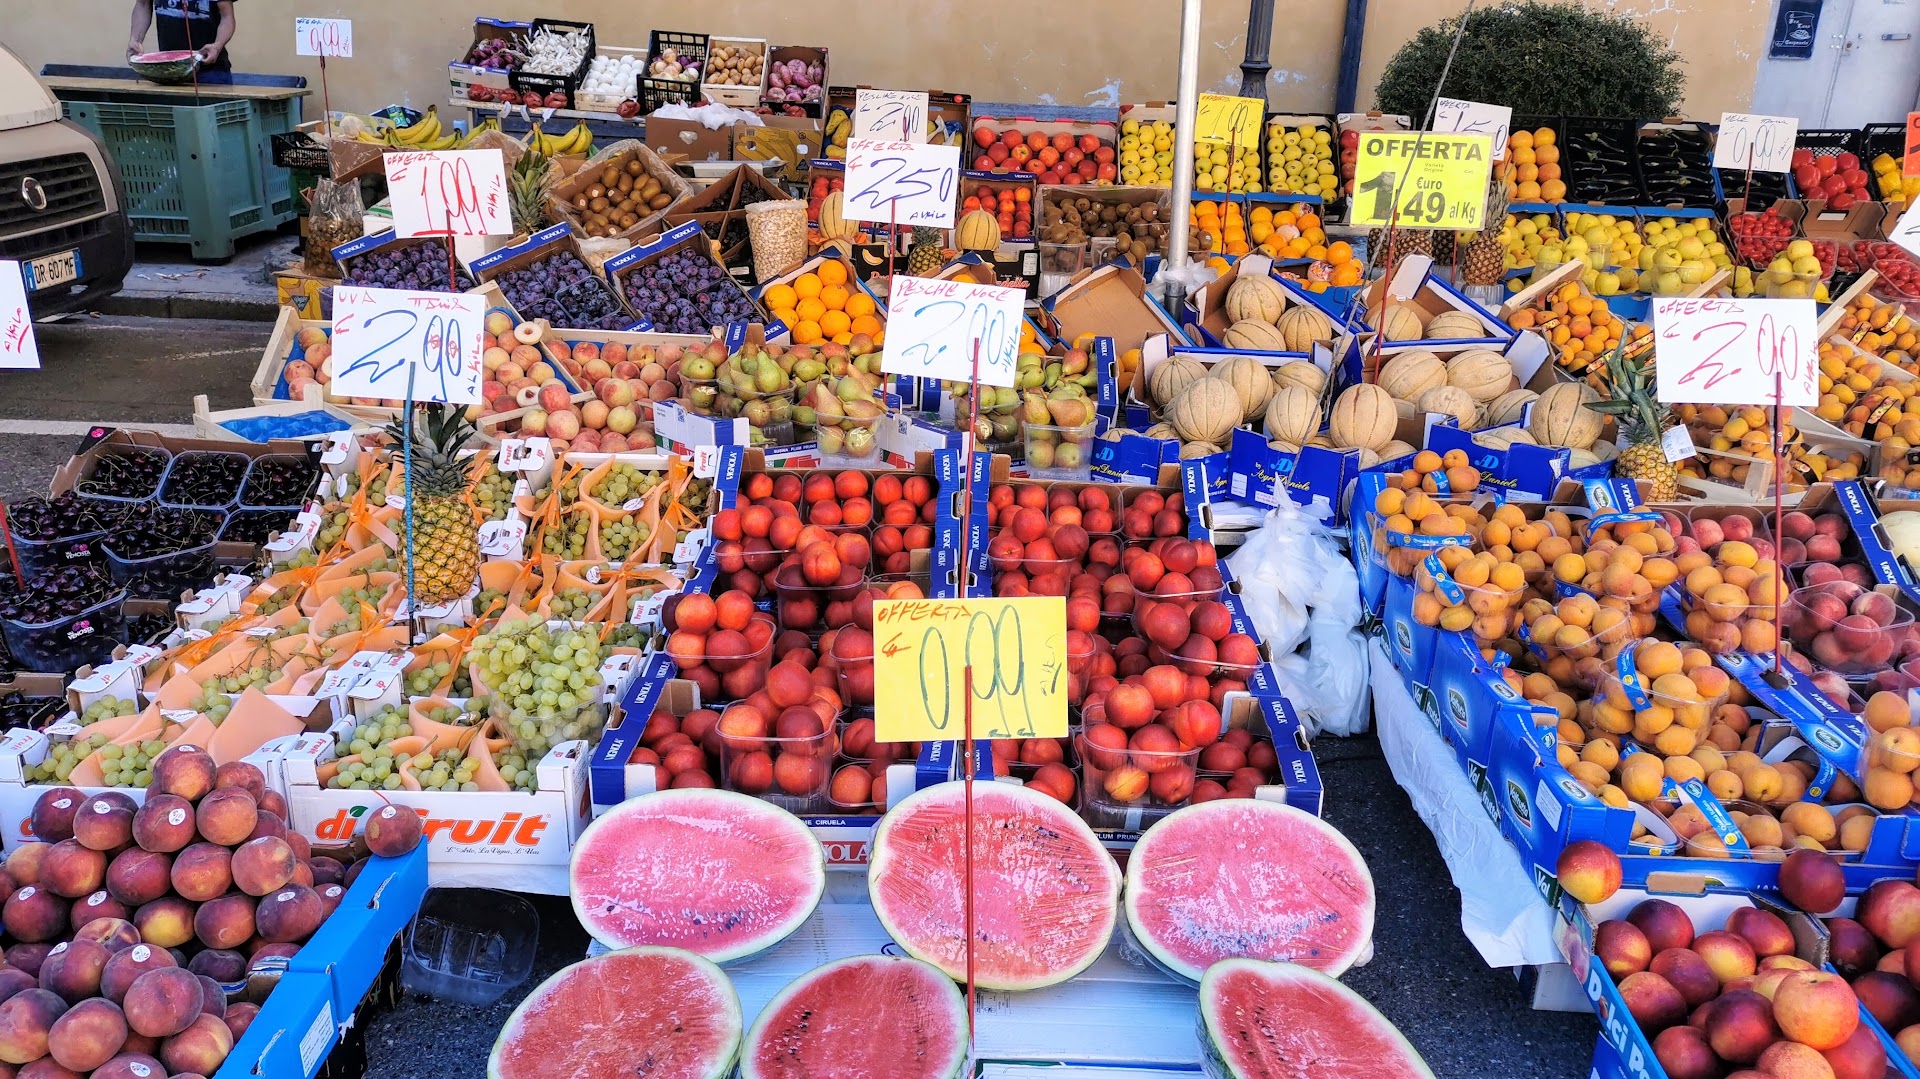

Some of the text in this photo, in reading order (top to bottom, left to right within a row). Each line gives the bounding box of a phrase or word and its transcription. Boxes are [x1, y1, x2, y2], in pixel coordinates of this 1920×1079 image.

[1439, 100, 1470, 109] OFFERTA
[1724, 115, 1749, 123] MELE
[851, 142, 914, 153] OFFERTA
[1366, 138, 1482, 162] OFFERTA
[387, 152, 441, 166] OFFERTA
[1449, 204, 1460, 220] al
[1462, 202, 1476, 224] Kg
[541, 228, 566, 240] VIGNOLA
[671, 226, 697, 240] VIGNOLA
[339, 242, 365, 255] VIGNOLA
[34, 257, 73, 284] DR 607MF
[477, 253, 503, 267] VIGNOLA
[612, 253, 637, 267] VIGNOLA
[339, 290, 376, 305] UVA
[897, 280, 1012, 303] PESCHE NOCE
[1659, 299, 1744, 316] OFFERTA
[504, 445, 514, 465] fruit
[699, 452, 708, 472] fruit
[725, 452, 737, 480] VIGNOLA
[974, 457, 982, 482] VIGNOLA
[1186, 467, 1196, 494] VIGNOLA
[1845, 486, 1863, 514] VIGNOLA
[1880, 561, 1898, 584] VIGNO
[634, 603, 645, 621] fruit
[878, 602, 973, 624] OFFERTA
[637, 681, 654, 704] VIGNOLA
[1414, 685, 1423, 706] Val
[1272, 700, 1287, 725] VIGNOLA
[604, 738, 625, 761] VIGNOLA
[1291, 758, 1307, 785] VIGNOLA
[1469, 762, 1480, 784] Val
[315, 808, 366, 842] di
[816, 819, 847, 827] CIRUELA
[1537, 873, 1550, 897] Val
